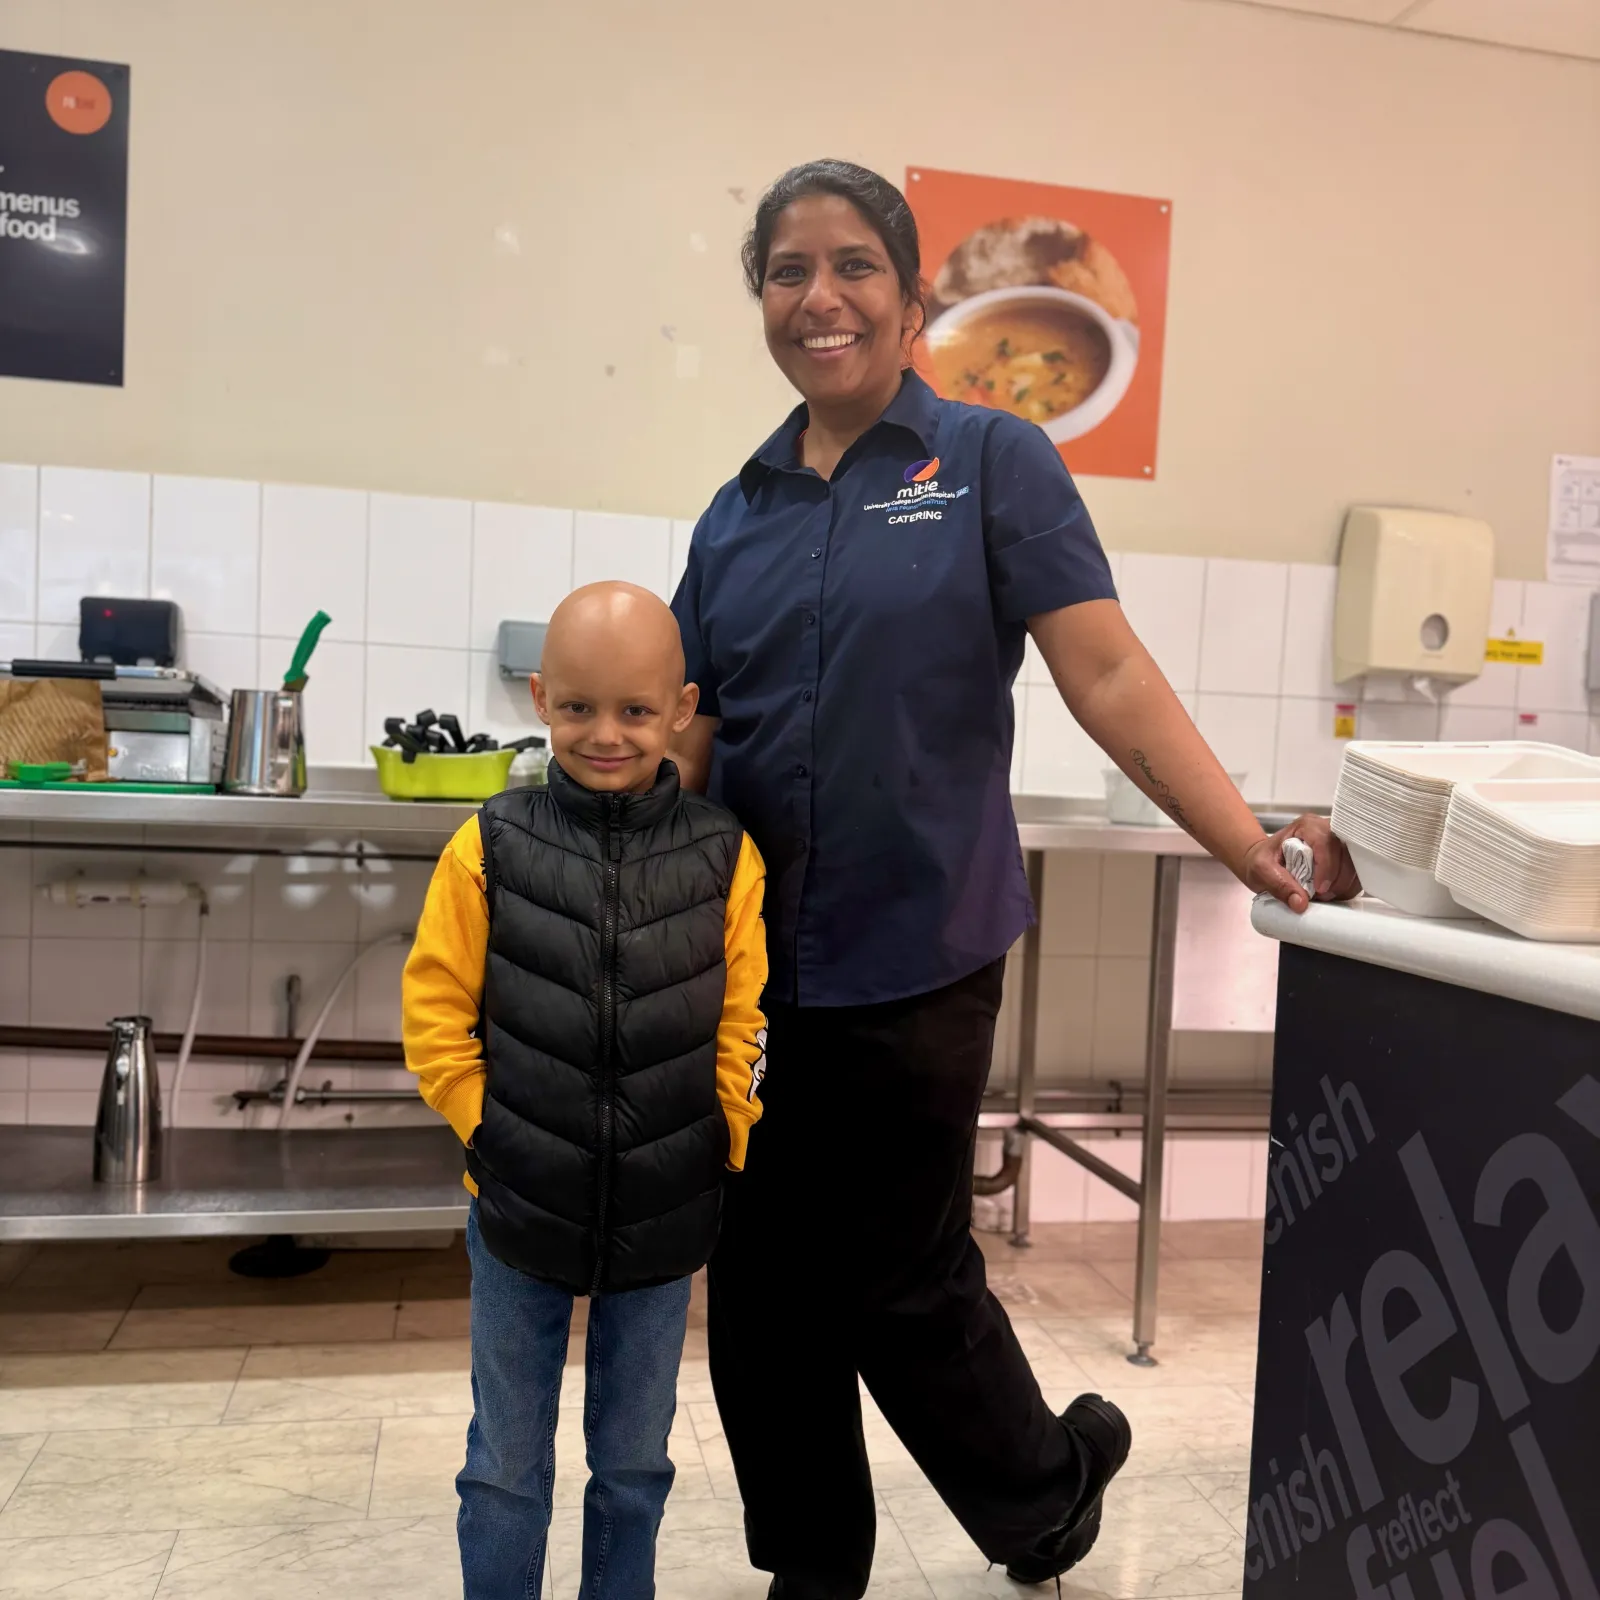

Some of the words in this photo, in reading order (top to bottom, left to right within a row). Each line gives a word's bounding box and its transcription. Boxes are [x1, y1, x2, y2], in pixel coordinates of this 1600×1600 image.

[0, 211, 56, 241] food
[863, 501, 890, 511] University
[928, 490, 955, 499] Hospitals
[897, 481, 938, 499] mitie
[888, 510, 942, 524] CATERING
[1304, 1073, 1600, 1514] rela
[1376, 1469, 1472, 1567] reflect
